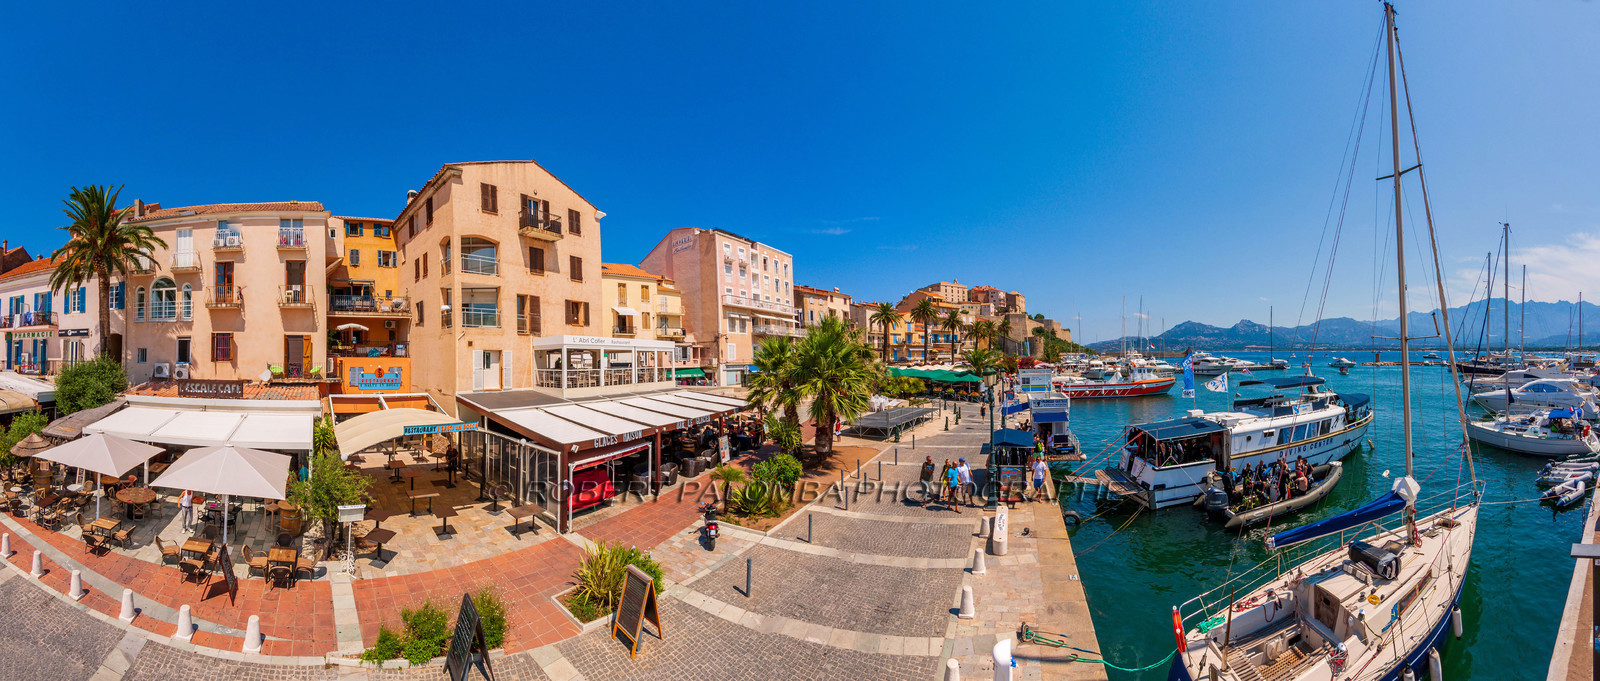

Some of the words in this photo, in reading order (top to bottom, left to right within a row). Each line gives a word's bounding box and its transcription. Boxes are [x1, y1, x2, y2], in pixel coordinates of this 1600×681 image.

[14, 331, 53, 339] PHARMACIE
[404, 425, 436, 434] RESTAURANT
[594, 434, 618, 449] GLACES
[622, 430, 643, 443] MAISON
[1310, 437, 1334, 450] CENTER
